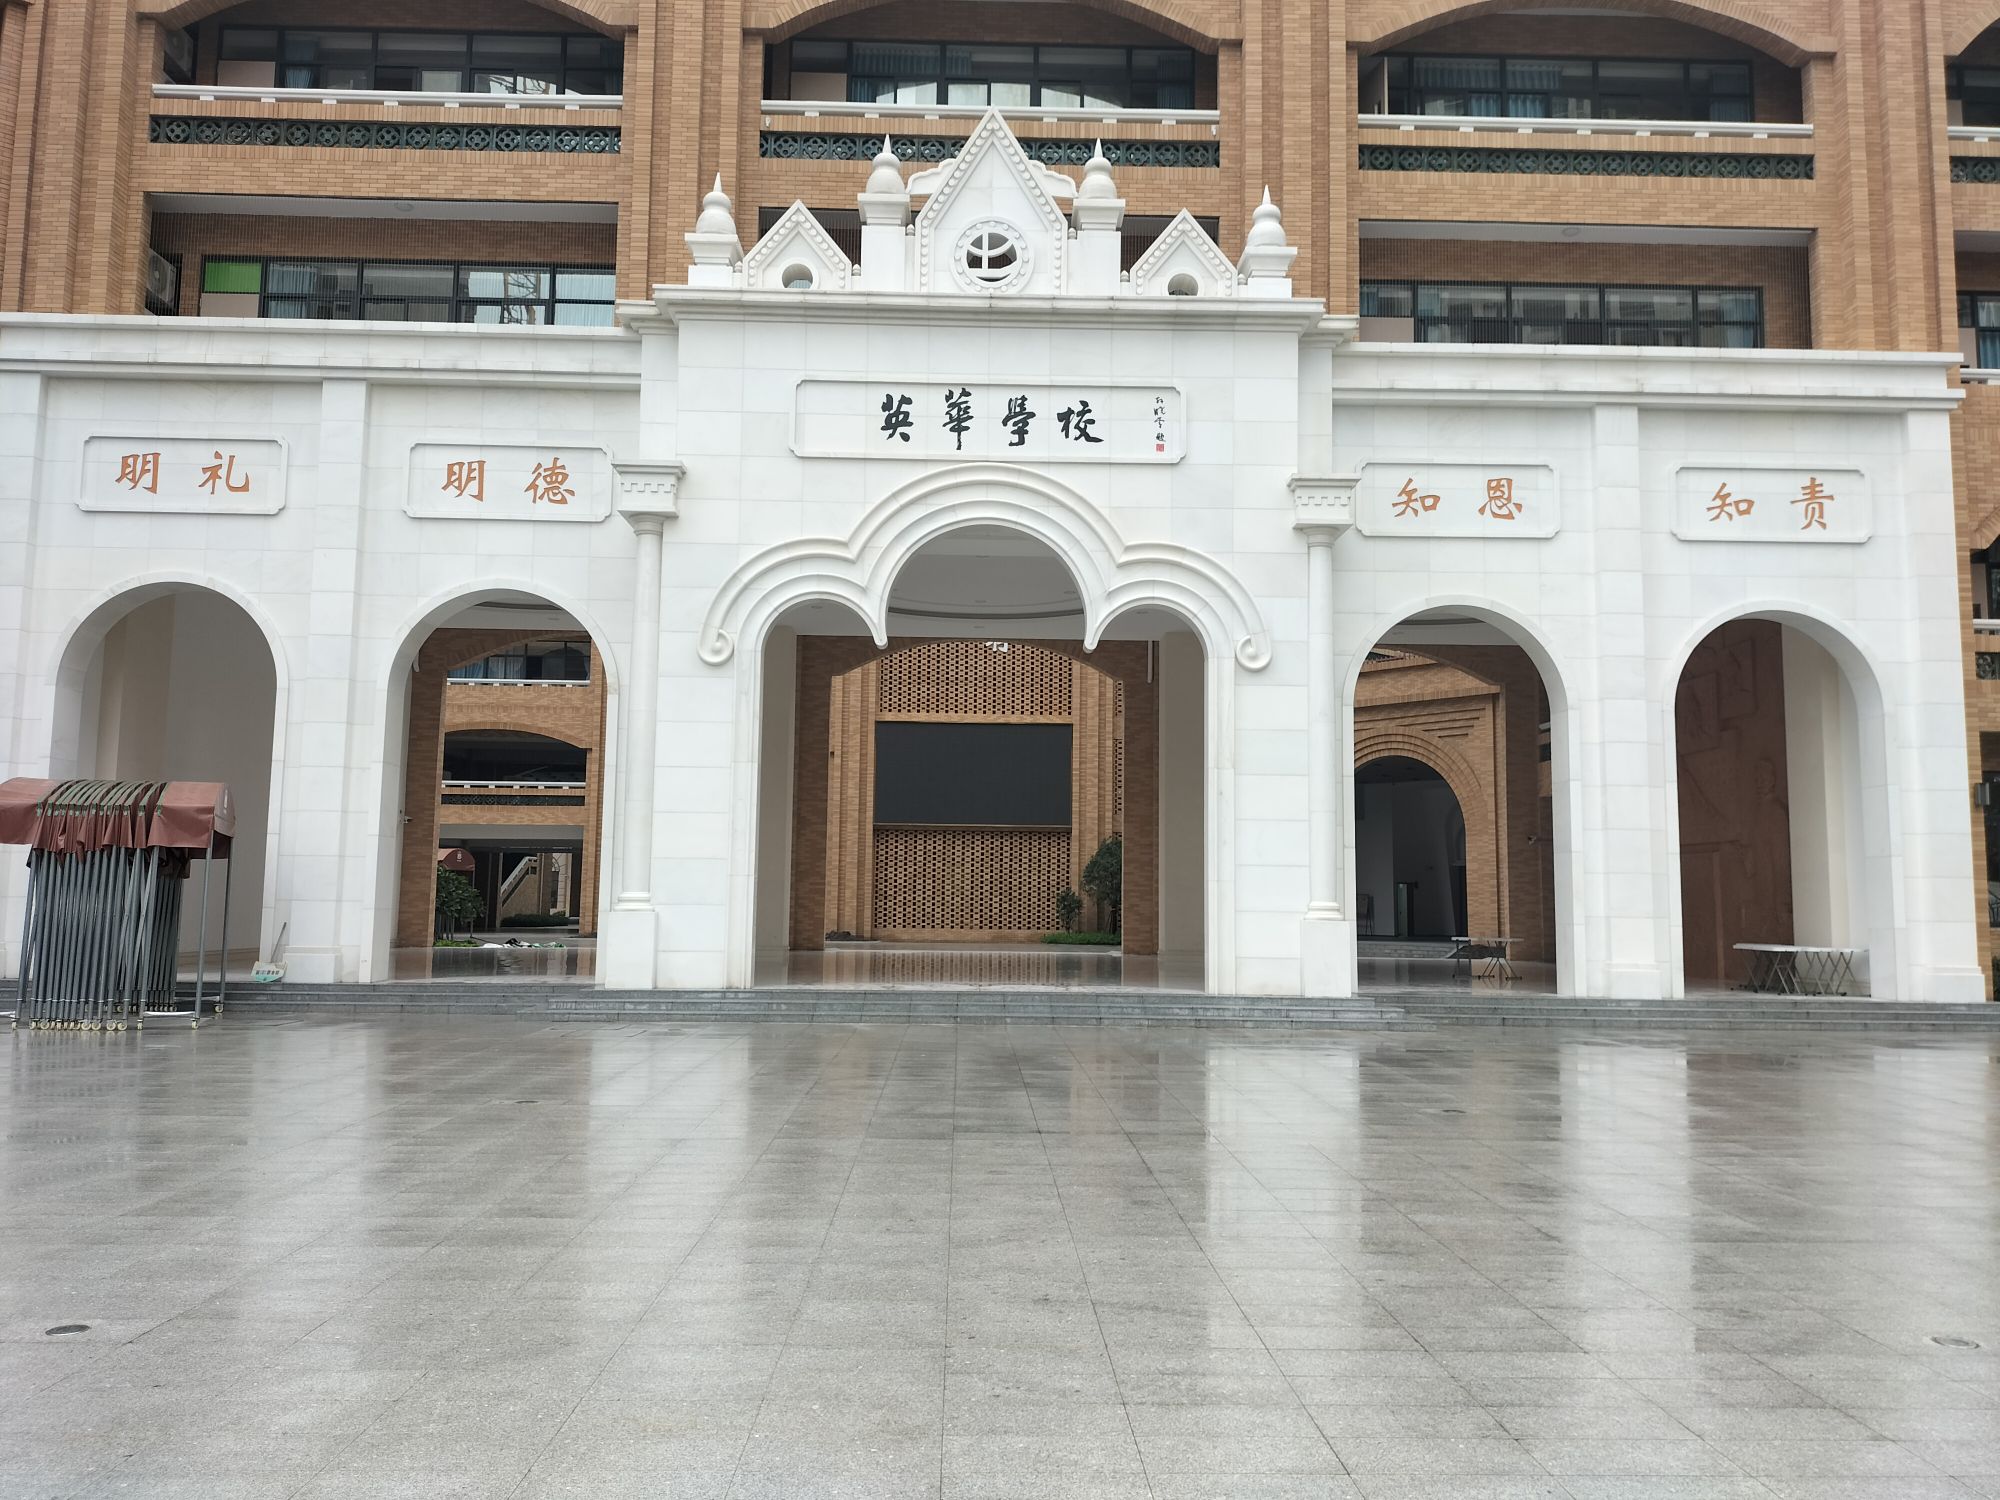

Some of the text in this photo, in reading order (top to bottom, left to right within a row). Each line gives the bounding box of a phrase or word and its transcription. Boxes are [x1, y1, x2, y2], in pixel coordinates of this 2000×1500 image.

[880, 387, 1104, 450] 英華學校
[115, 451, 250, 495] 明礼
[442, 456, 575, 504] 明德
[1392, 477, 1522, 521] 知恩
[1706, 477, 1834, 531] 知责
